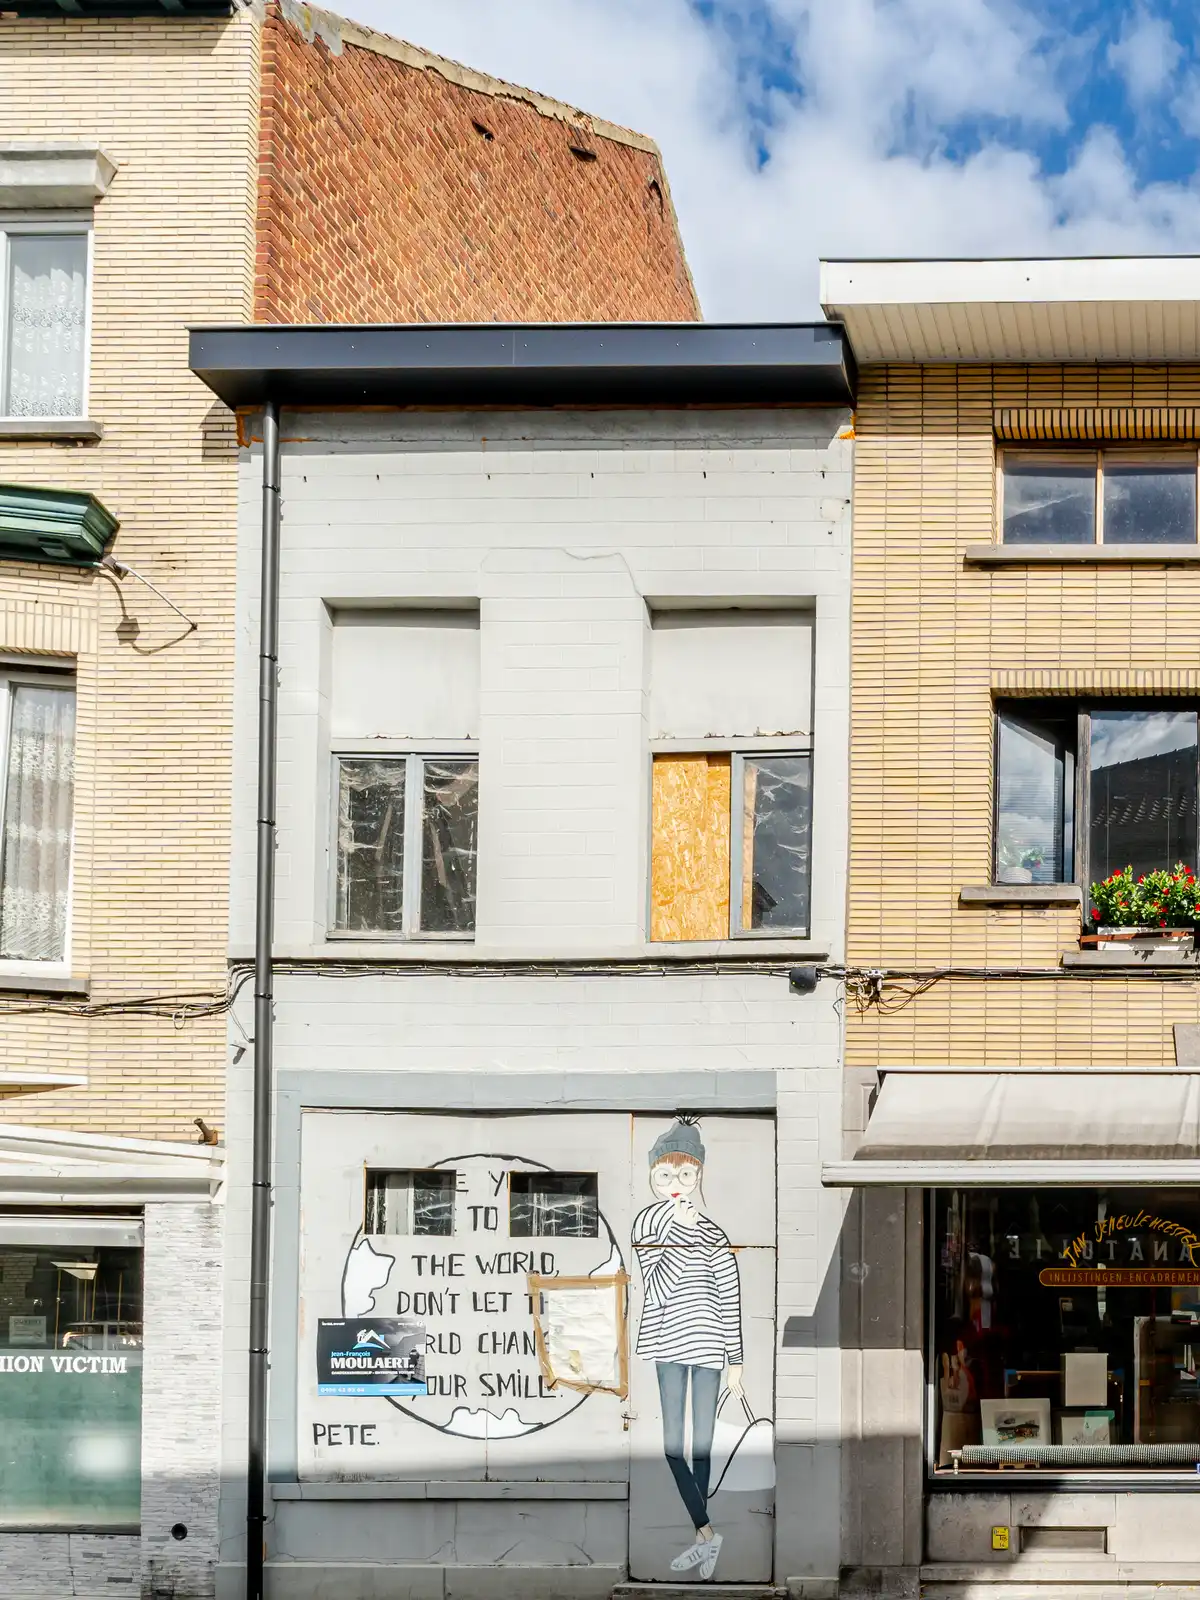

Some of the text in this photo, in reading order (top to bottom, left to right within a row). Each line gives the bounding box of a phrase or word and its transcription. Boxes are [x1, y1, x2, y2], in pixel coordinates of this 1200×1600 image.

[467, 1205, 498, 1231] TO
[1062, 1231, 1087, 1268] JAN
[411, 1250, 560, 1278] THE WORLD,
[397, 1287, 461, 1316] DON'T
[472, 1291, 513, 1314] LET
[331, 1350, 371, 1359] Jean-François
[424, 1331, 462, 1355] RLD
[50, 1356, 127, 1374] VICTIM
[330, 1357, 411, 1369] MOULAERT
[412, 1373, 468, 1402] OUR
[312, 1422, 380, 1447] PETE.
